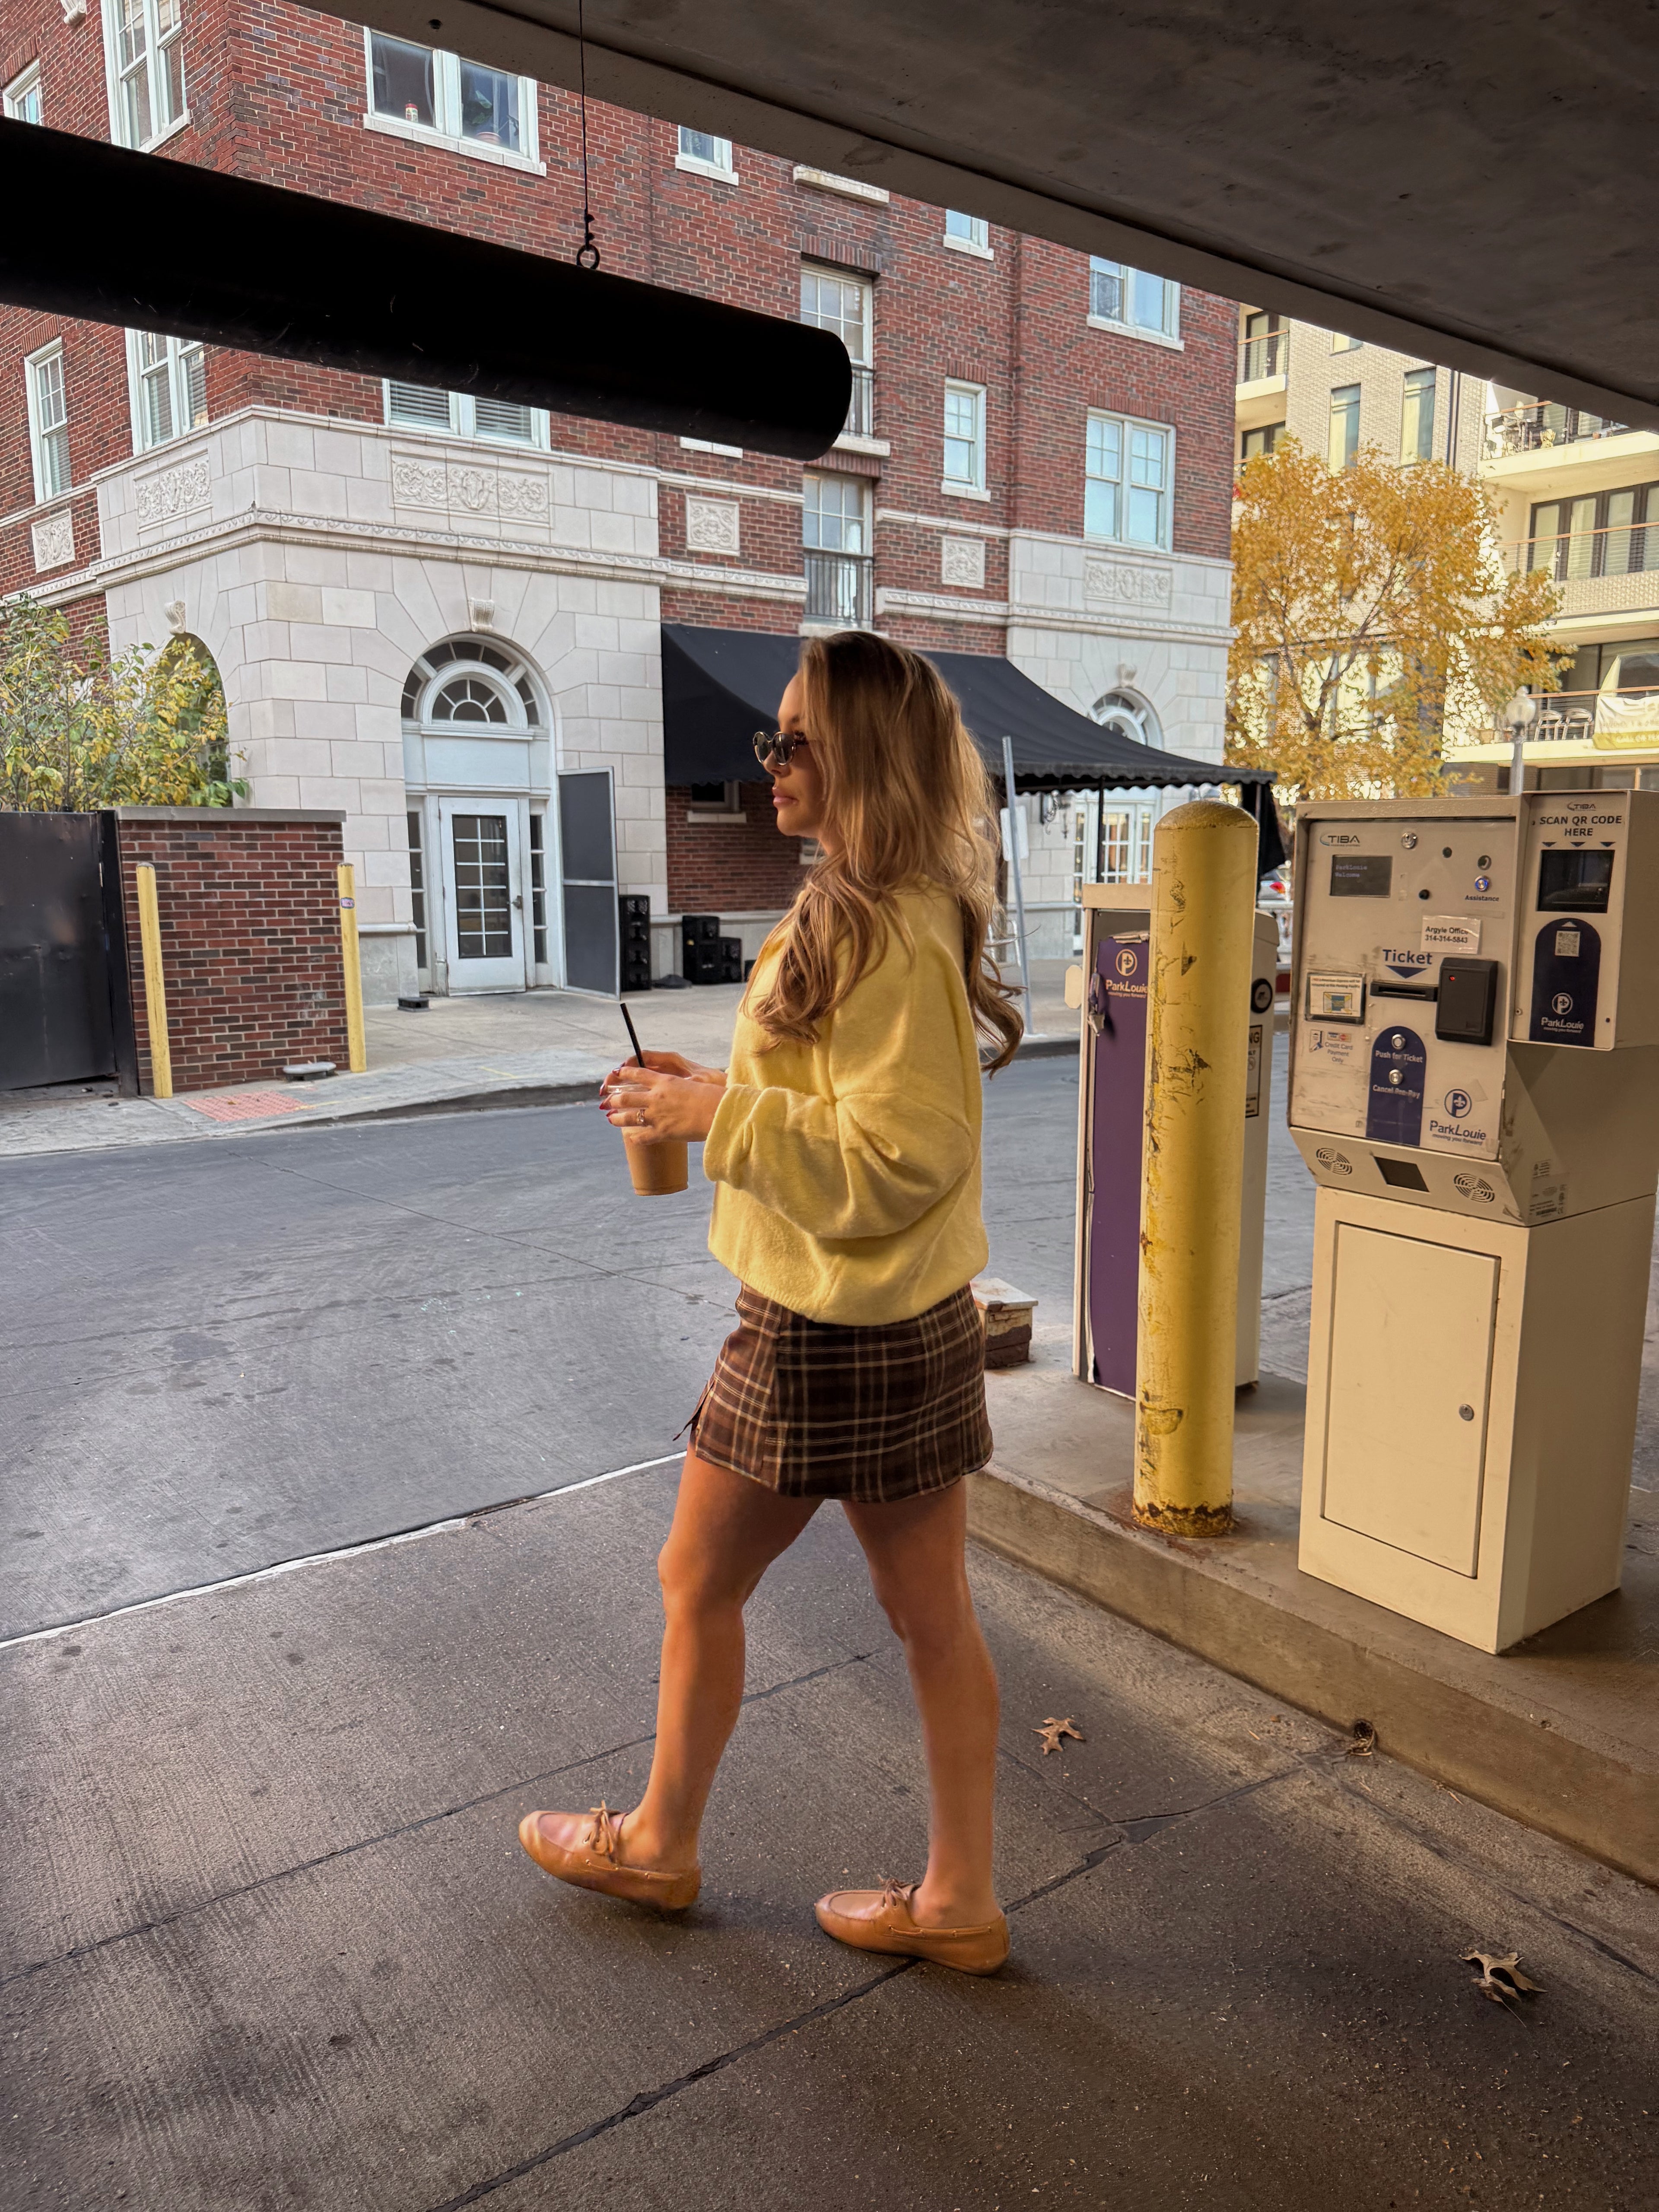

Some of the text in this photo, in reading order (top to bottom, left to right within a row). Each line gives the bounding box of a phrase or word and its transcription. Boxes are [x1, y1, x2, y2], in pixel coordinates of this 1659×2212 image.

[1540, 816, 1622, 826] SCAN QR CODE
[1564, 828, 1593, 836] HERE
[1328, 835, 1360, 843] TIBA
[1382, 949, 1433, 965] Ticket
[1106, 979, 1148, 993] ParkLouie
[1541, 1017, 1584, 1029] ParkLouie
[1375, 1050, 1391, 1058] Push
[1403, 1054, 1423, 1063] Ticket
[1373, 1084, 1394, 1094] Cancel
[1430, 1120, 1486, 1140] ParkLouie
